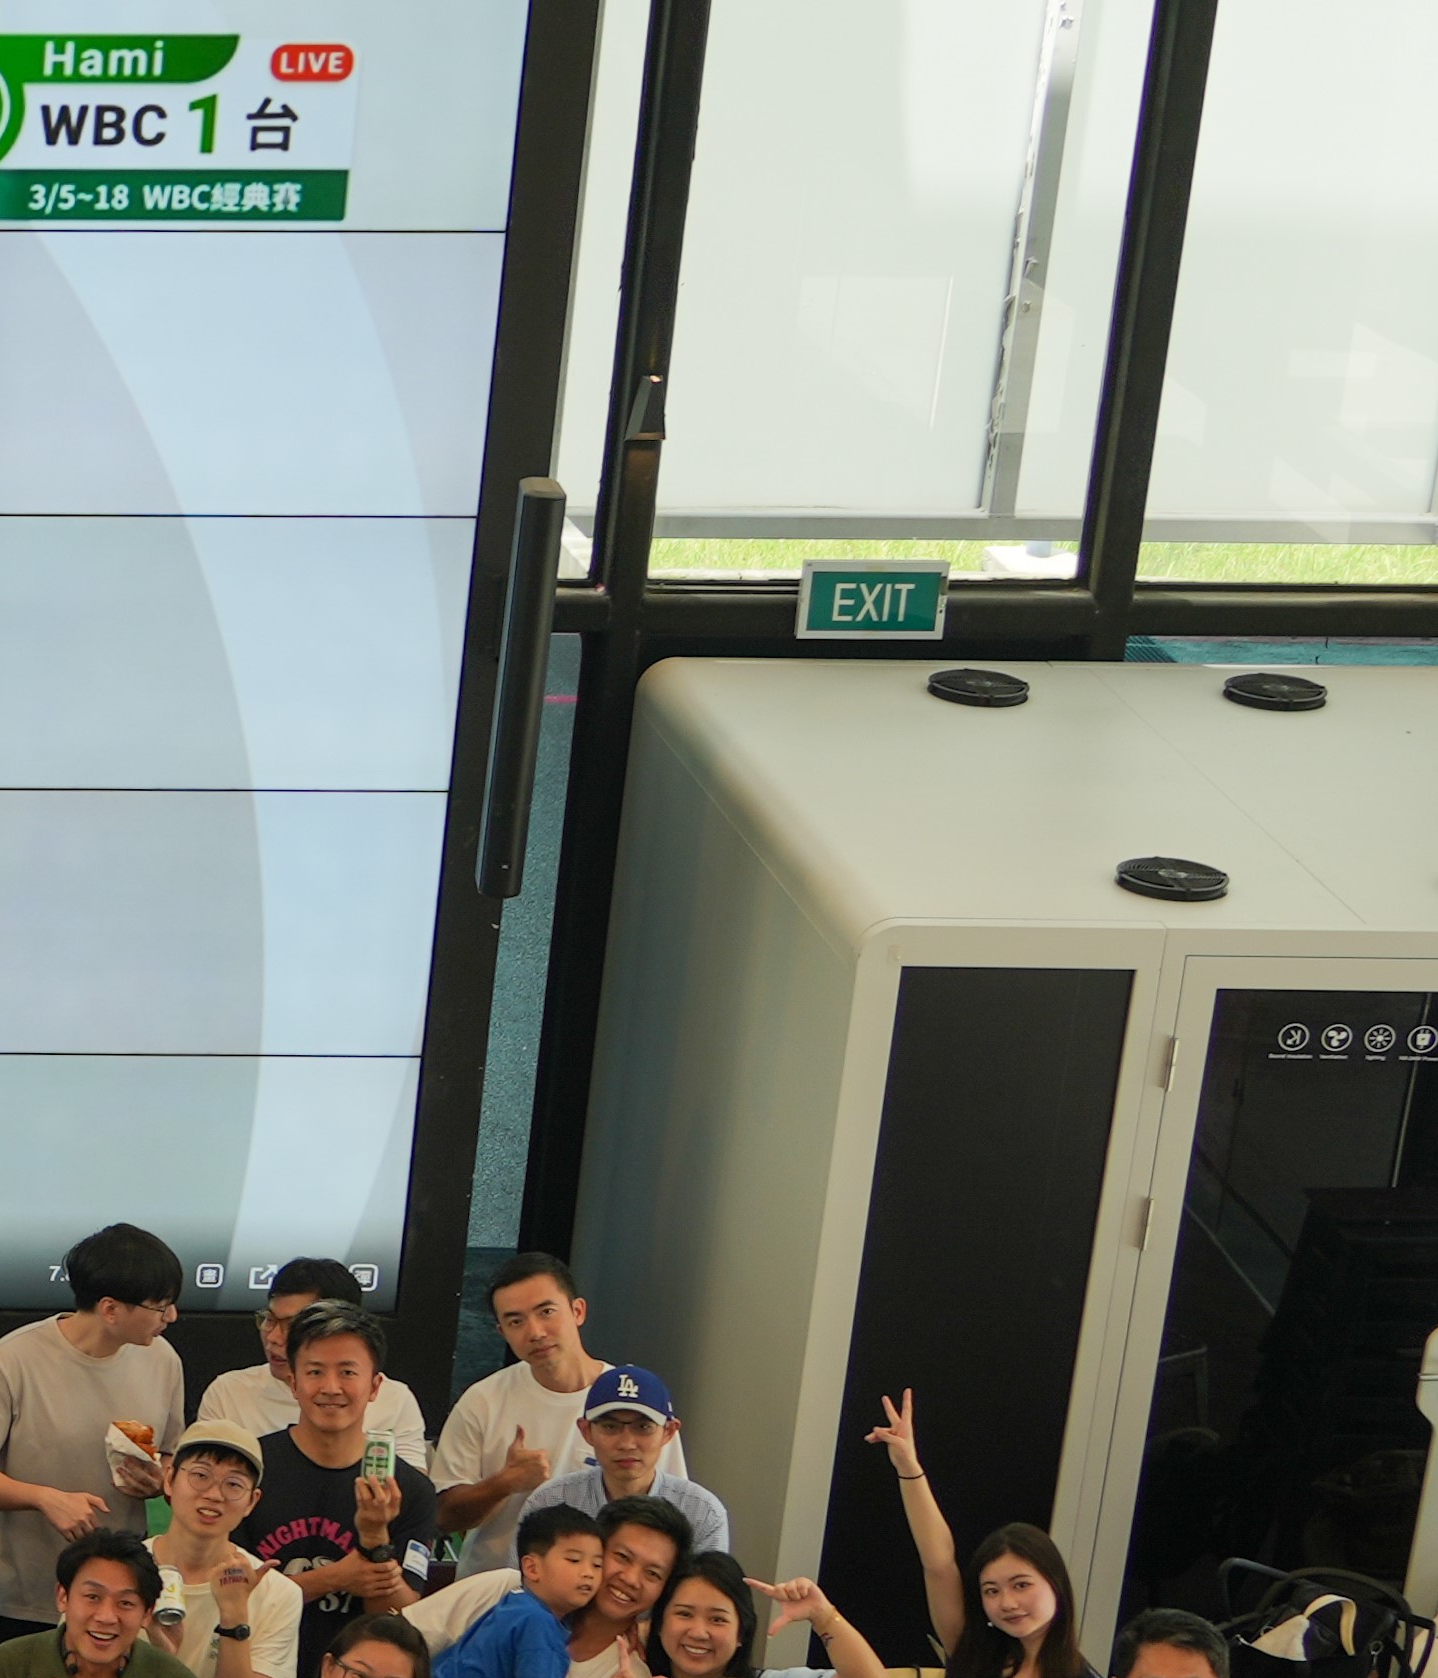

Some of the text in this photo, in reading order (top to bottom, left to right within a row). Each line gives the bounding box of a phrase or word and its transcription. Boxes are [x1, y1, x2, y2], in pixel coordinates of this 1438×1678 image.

[41, 40, 164, 78] Hami
[279, 53, 344, 73] LIVE
[40, 93, 299, 154] WBC 1 台
[28, 182, 302, 213] 3/5~18 WBC經典賽
[831, 582, 916, 622] EXIT
[617, 1374, 639, 1398] LA
[255, 1517, 354, 1561] NIGHTMA
